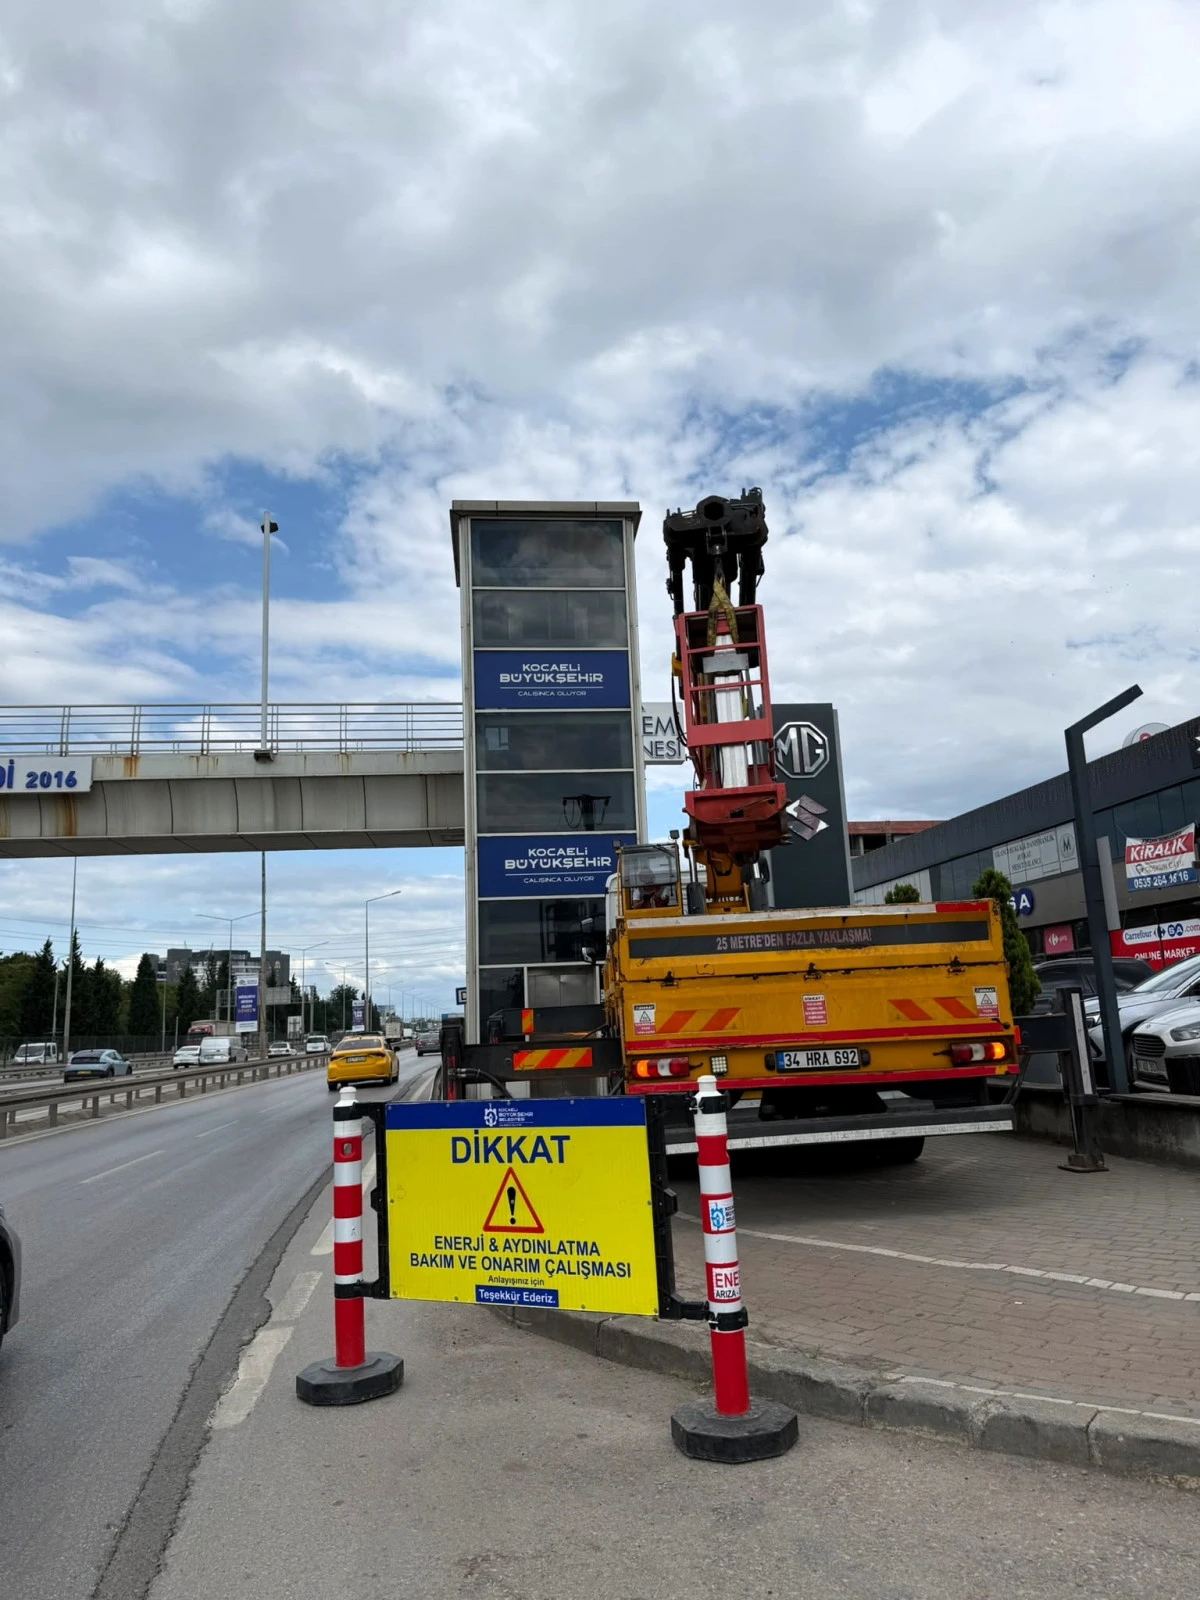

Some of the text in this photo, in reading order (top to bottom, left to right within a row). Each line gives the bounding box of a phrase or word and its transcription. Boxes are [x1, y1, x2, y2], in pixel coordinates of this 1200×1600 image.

[499, 673, 604, 684] BÜYÜKŞEHİR
[776, 727, 823, 774] MG
[25, 770, 77, 789] 2016
[504, 856, 612, 870] BÜYÜKŞEHİR
[1133, 877, 1151, 889] 0535
[1153, 874, 1167, 887] 264
[1178, 870, 1189, 882] 16
[716, 928, 872, 950] 25 METRE'DEN FAZLA YAKLAŞMA!
[1124, 930, 1152, 941] Carrefour
[1163, 946, 1196, 960] MARKET
[784, 1050, 858, 1067] 34 HRA 692
[451, 1129, 571, 1164] DİKKAT
[434, 1233, 600, 1257] ENERJİ & AYDINLATMA
[410, 1253, 631, 1280] BAKIM VE ONARIM ÇALIŞMASI
[487, 1274, 545, 1287] Anlayışınız için
[478, 1288, 556, 1304] Teşekkür Ederiz.
